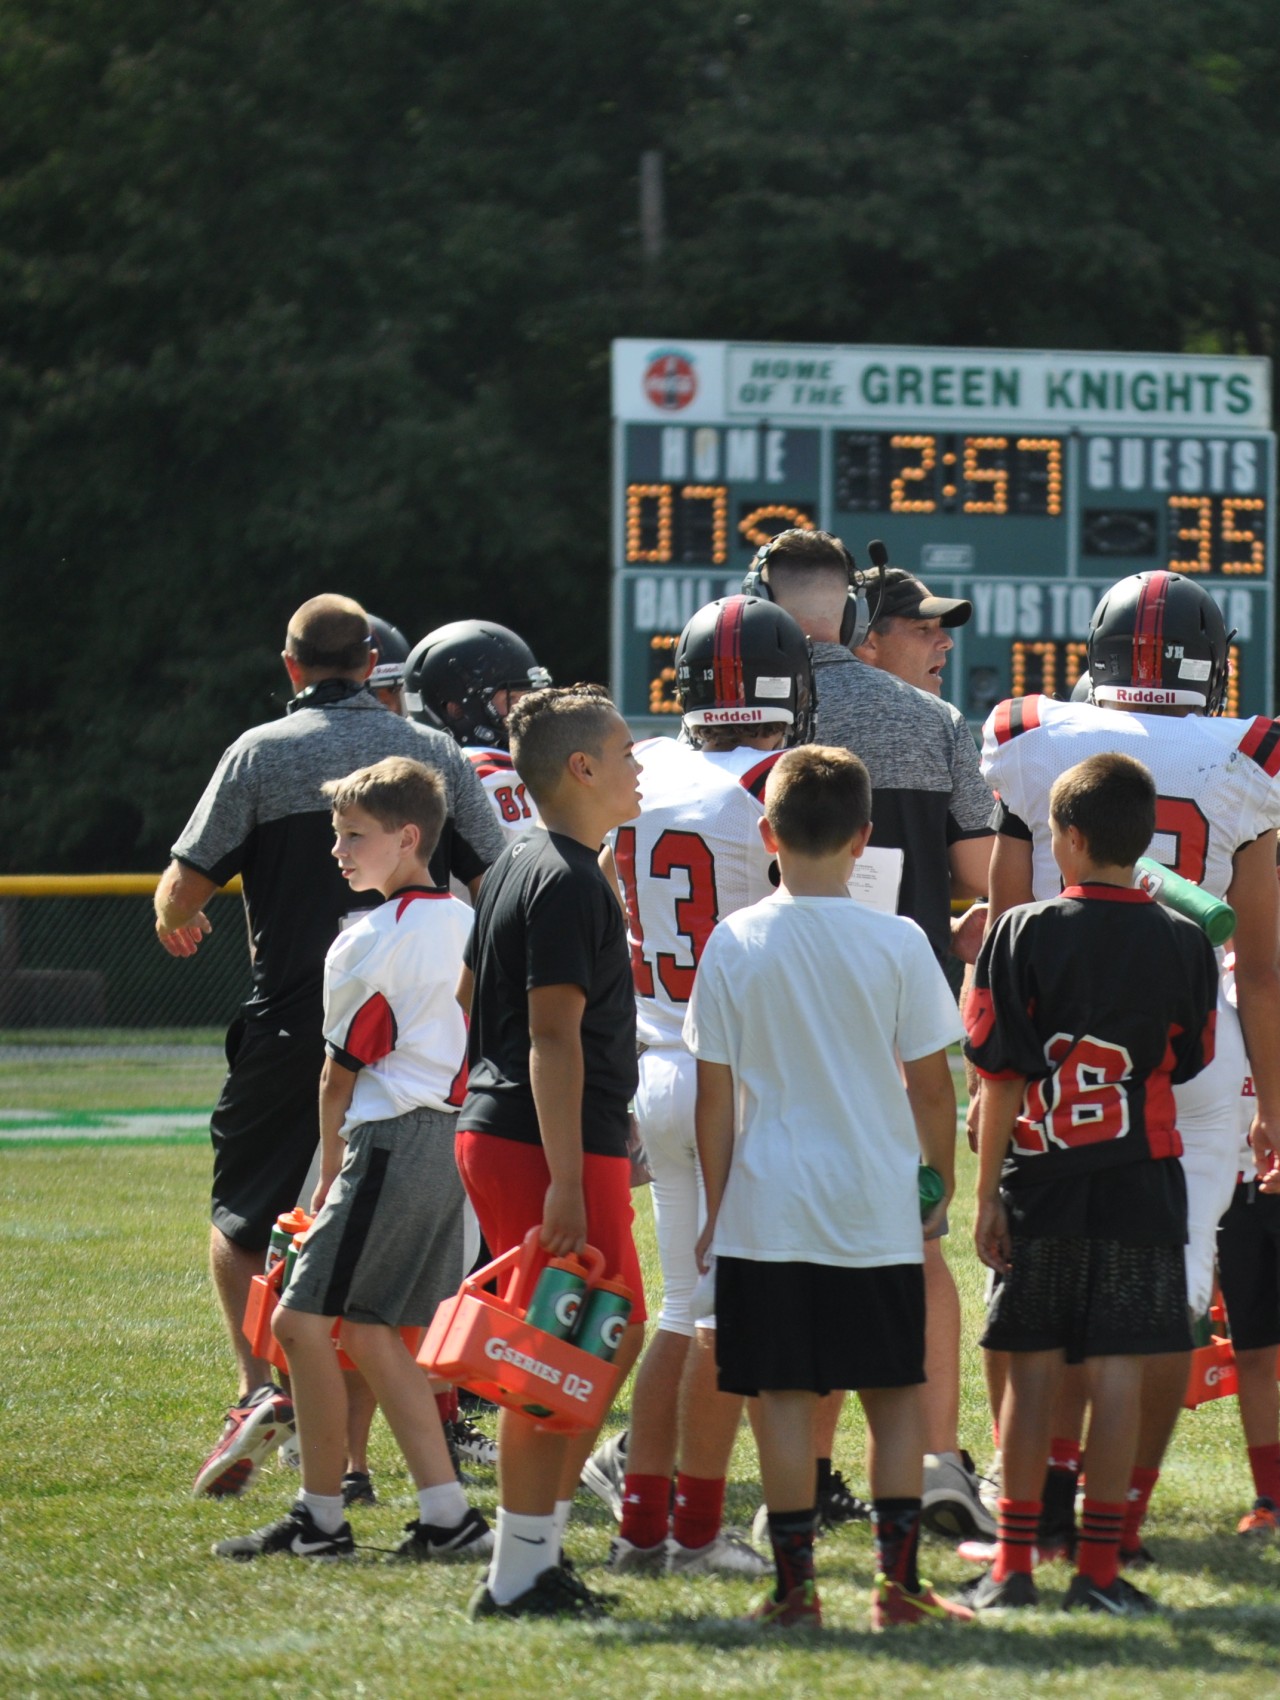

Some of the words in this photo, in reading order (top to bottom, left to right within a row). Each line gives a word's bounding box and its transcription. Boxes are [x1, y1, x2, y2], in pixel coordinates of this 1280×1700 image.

[752, 358, 837, 380] HOME
[740, 384, 776, 404] OF
[791, 385, 847, 405] THE
[861, 364, 1020, 406] GREEN
[1047, 369, 1253, 414] KNIGHTS
[661, 426, 785, 484] HOME
[1088, 437, 1257, 491] GUESTS
[890, 435, 1060, 514] 2:57
[626, 484, 727, 563] 07
[1168, 496, 1264, 574] 35
[972, 583, 1042, 637] YDS
[1049, 585, 1092, 637] TO
[1165, 646, 1184, 659] JH
[703, 668, 714, 680] 13
[1116, 689, 1175, 704] Riddell
[704, 709, 762, 723] Riddell
[494, 783, 531, 822] 81
[614, 826, 719, 1002] 13
[555, 1293, 582, 1327] G
[601, 1315, 628, 1349] G
[562, 1373, 593, 1402] 02
